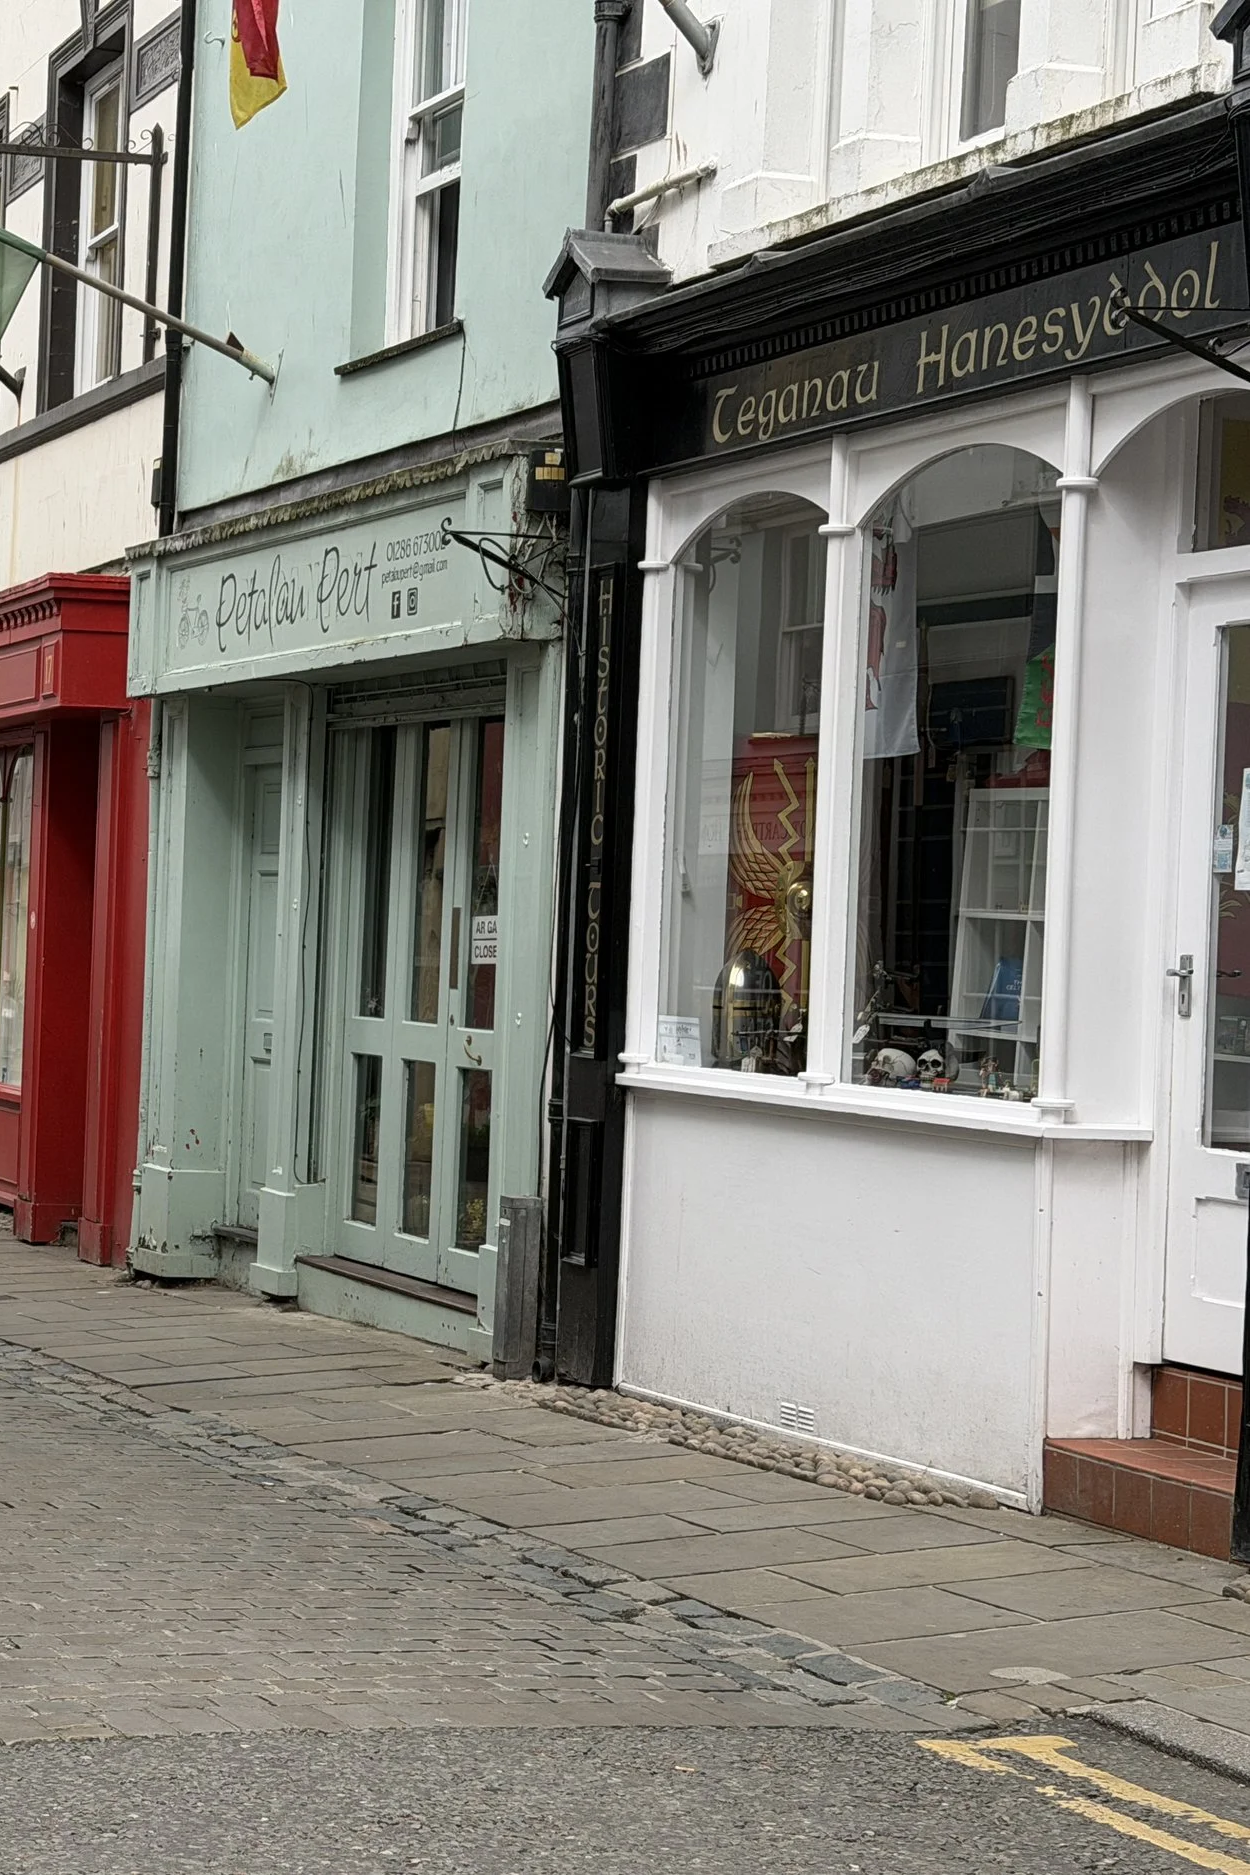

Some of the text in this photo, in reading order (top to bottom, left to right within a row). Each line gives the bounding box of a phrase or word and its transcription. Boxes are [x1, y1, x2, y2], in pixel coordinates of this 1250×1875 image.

[713, 361, 880, 444] Teganau
[386, 539, 411, 562] 01286
[476, 921, 486, 934] AR
[474, 945, 498, 959] CLOSE
